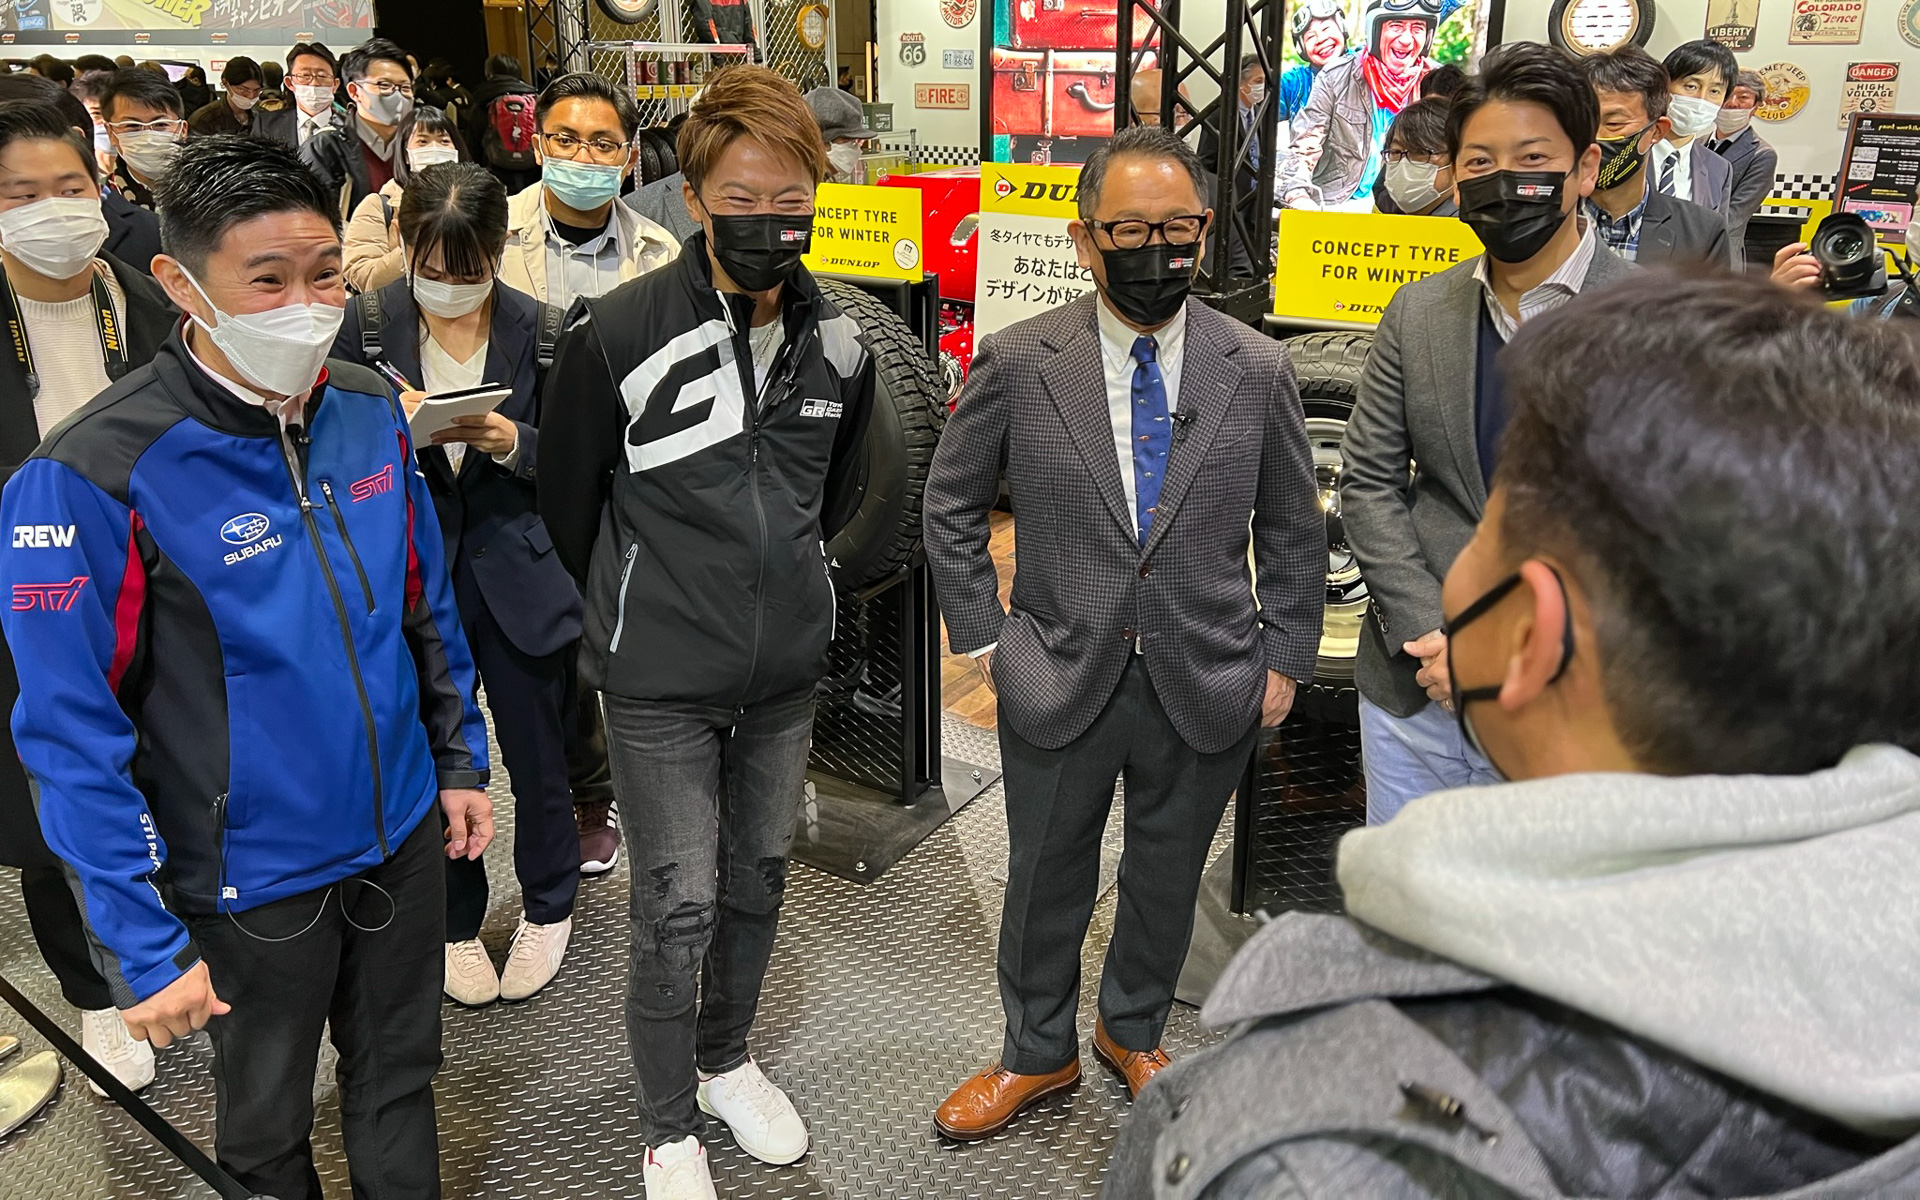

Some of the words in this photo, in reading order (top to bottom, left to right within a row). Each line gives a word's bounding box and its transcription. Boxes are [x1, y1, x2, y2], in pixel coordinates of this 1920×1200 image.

[942, 8, 963, 25] MOTOR
[964, 0, 975, 21] FUE
[1797, 1, 1862, 13] COLORADO
[1709, 27, 1752, 37] LIBERTY
[903, 45, 923, 63] 66
[944, 53, 952, 65] RT
[963, 54, 973, 66] 66
[1786, 66, 1806, 81] JEEP
[1852, 67, 1894, 76] DANGER
[928, 88, 956, 104] FIRE
[1761, 110, 1786, 119] CLUB
[813, 206, 858, 221] NCEPT
[864, 210, 897, 224] TYRE
[811, 226, 834, 239] FOR
[839, 227, 890, 243] WINTER
[1312, 239, 1400, 259] CONCEPT
[1409, 245, 1460, 263] TYRE
[830, 257, 880, 268] DUNLOP
[1322, 264, 1358, 280] FOR
[1367, 267, 1437, 284] WINTE
[986, 278, 1092, 305] デザインが好
[1349, 303, 1386, 314] DUN
[102, 309, 119, 351] Nikon
[12, 525, 76, 548] CREW
[223, 534, 283, 566] SUBARU
[140, 813, 156, 840] STI
